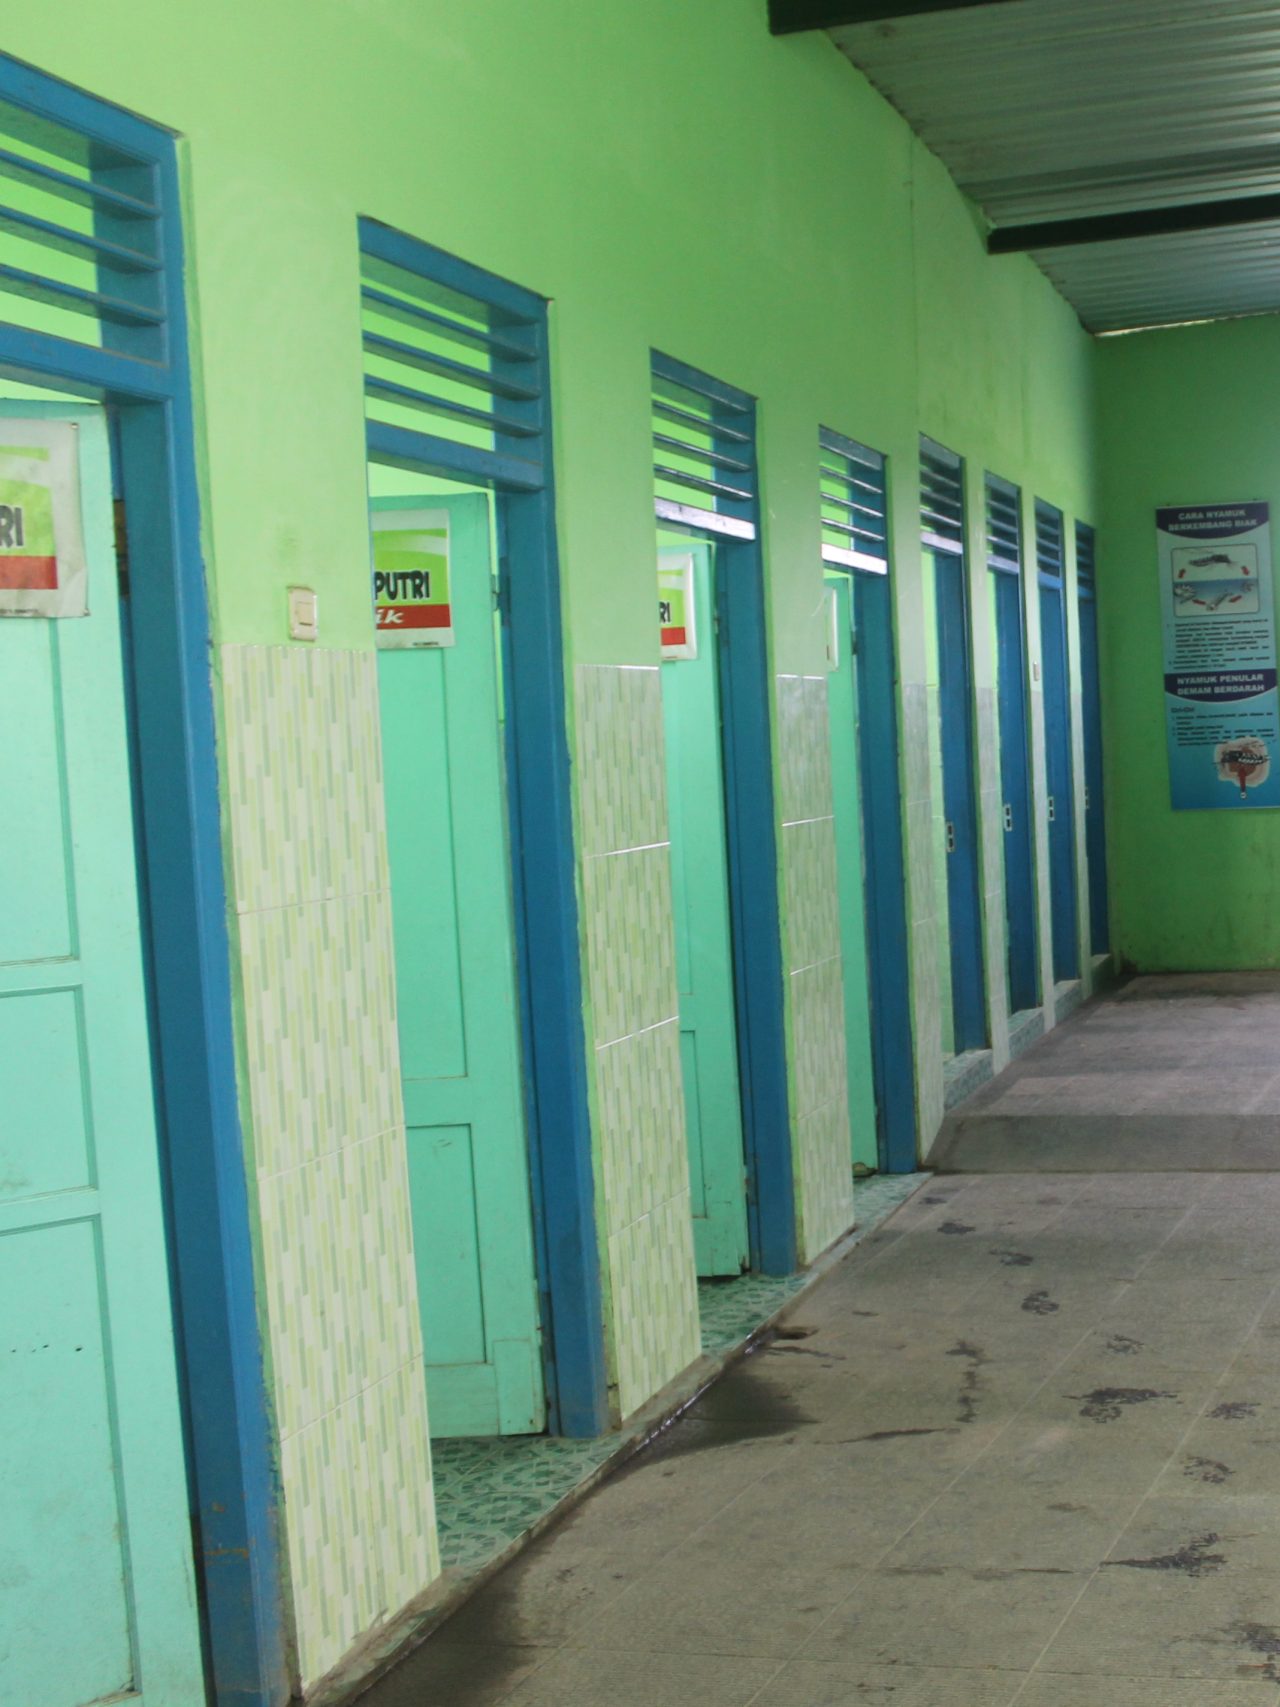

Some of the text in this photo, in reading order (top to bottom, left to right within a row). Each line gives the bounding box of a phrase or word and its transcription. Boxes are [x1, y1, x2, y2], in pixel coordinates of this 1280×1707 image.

[1178, 509, 1246, 520] CARA NYAMUK
[1168, 518, 1257, 531] BERKEMBANG BIAK
[374, 570, 430, 601] PUTRI
[1177, 674, 1264, 684] NYAMUK PENULAR
[1177, 684, 1265, 696] DEMAM BERDARAH
